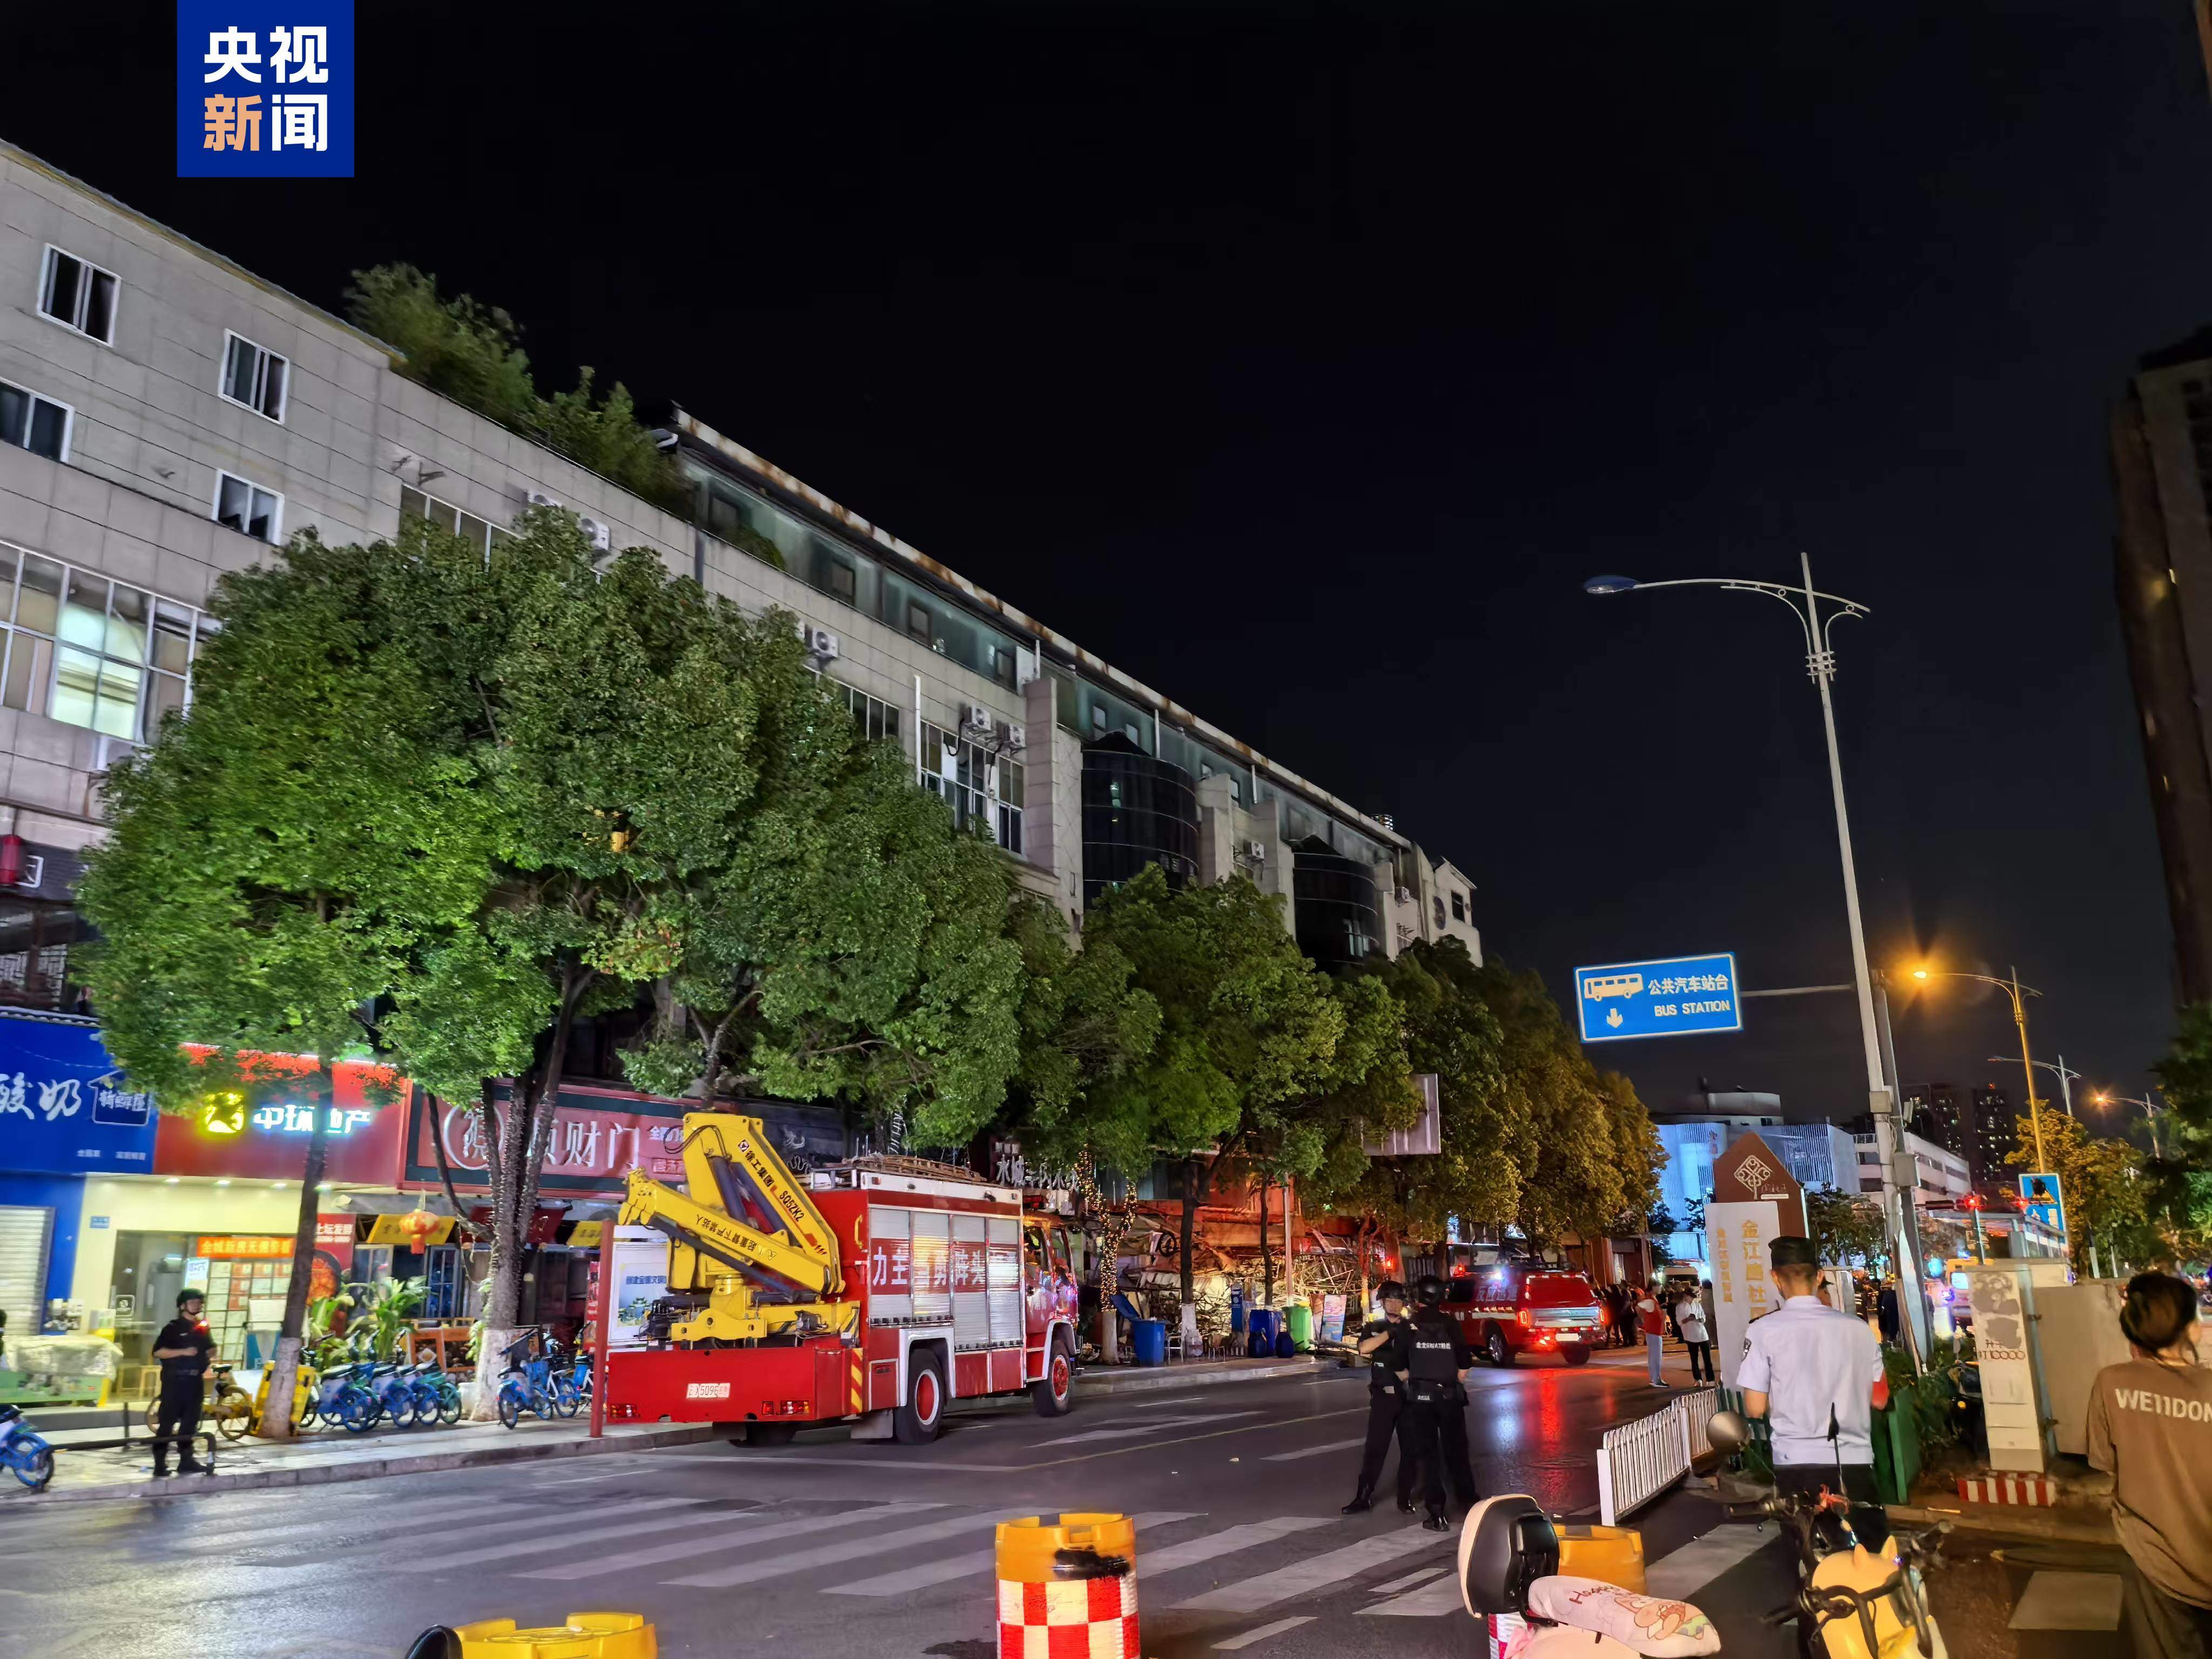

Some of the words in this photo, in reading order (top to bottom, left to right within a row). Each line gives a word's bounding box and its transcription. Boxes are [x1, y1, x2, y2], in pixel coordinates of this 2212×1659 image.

[1648, 974, 1729, 995] 公共汽车站台
[1654, 1004, 1677, 1016] BUS
[1682, 1000, 1730, 1015] STATION
[745, 1150, 774, 1187] 徐工集团
[779, 1190, 805, 1223] SQ5ZK2
